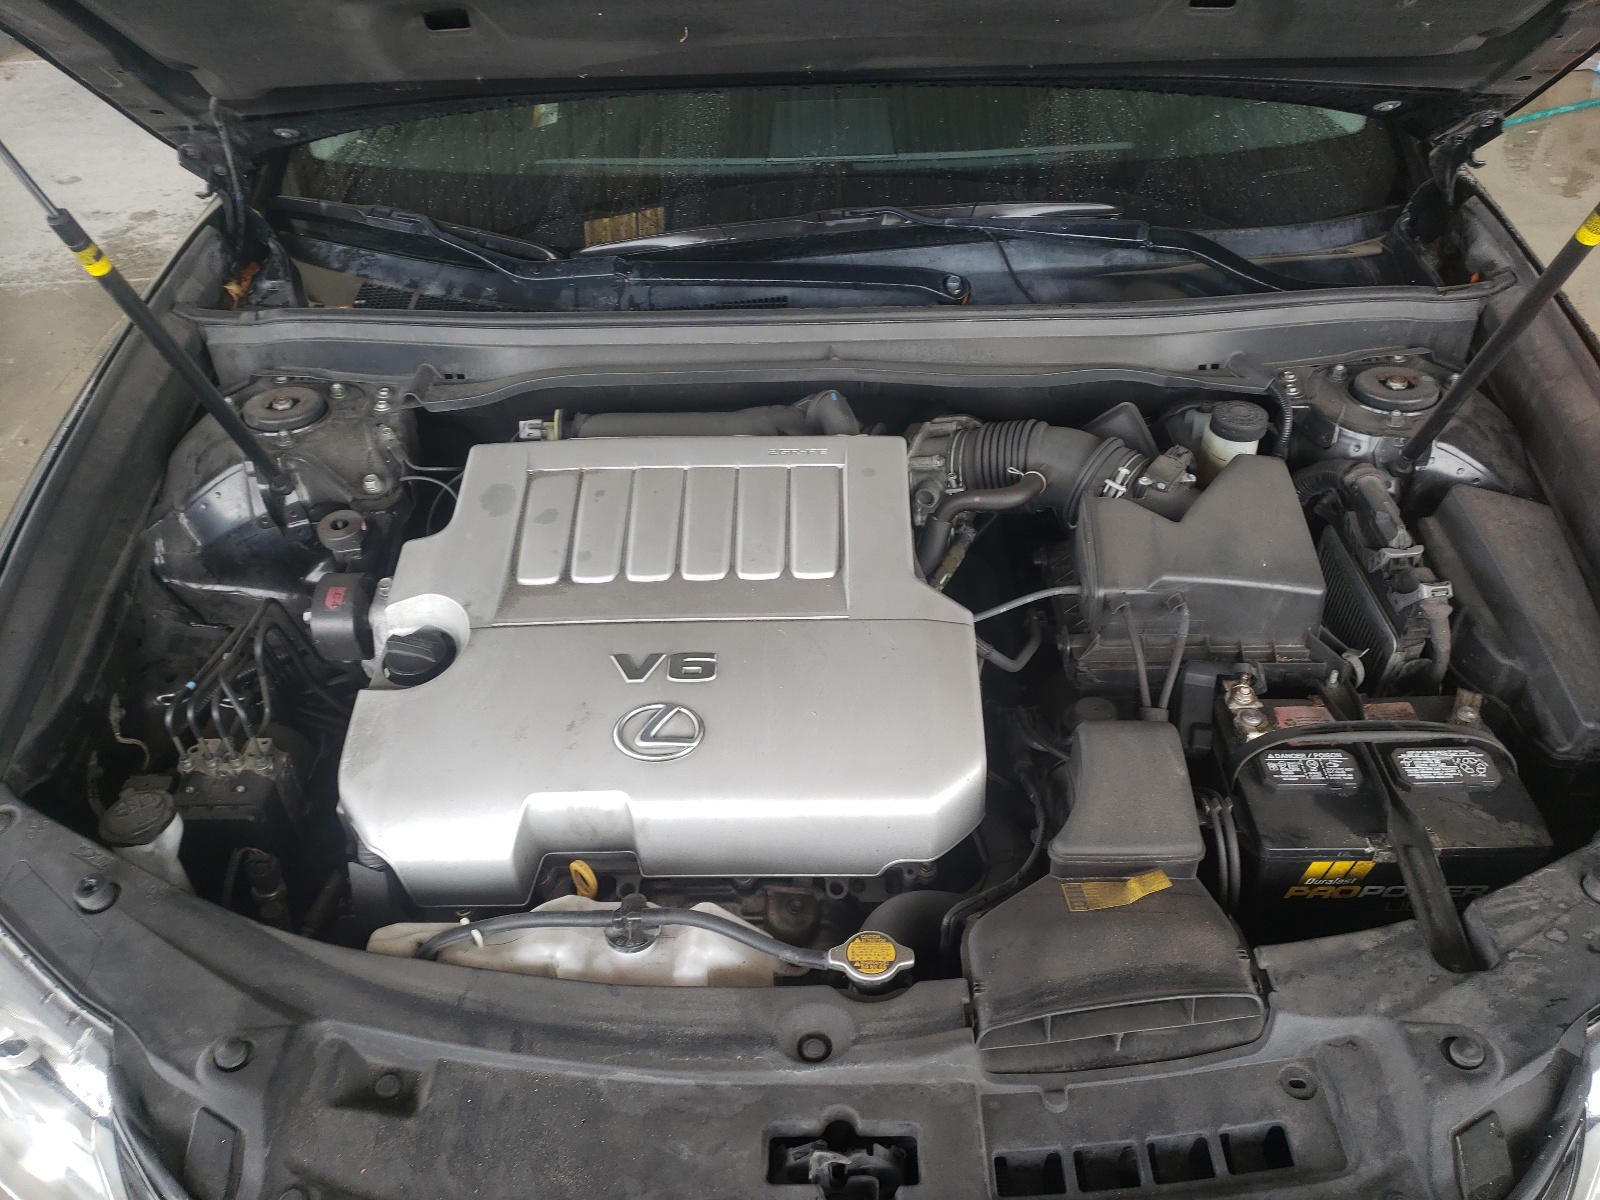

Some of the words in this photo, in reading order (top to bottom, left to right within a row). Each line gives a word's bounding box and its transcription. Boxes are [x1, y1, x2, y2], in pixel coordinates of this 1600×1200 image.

[609, 652, 717, 683] V6
[1303, 877, 1357, 885] Duralast
[1283, 885, 1489, 899] PROPOER
